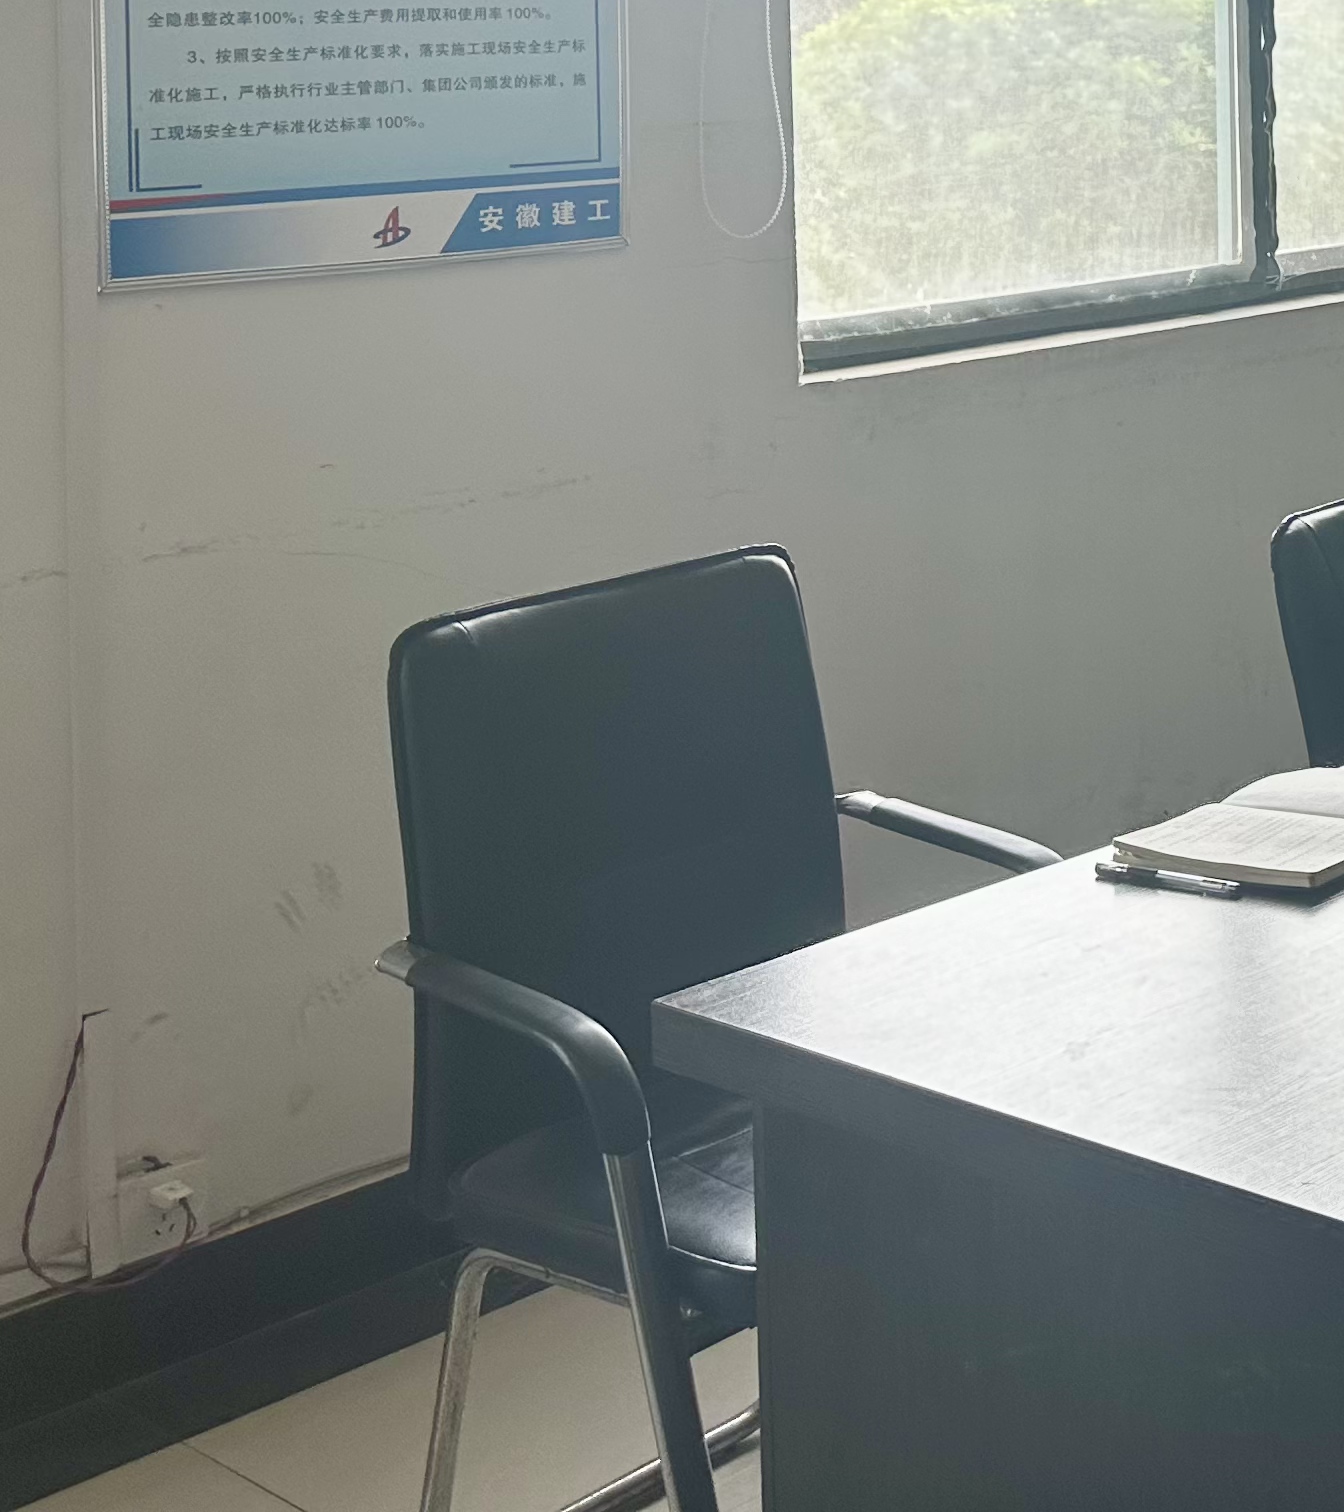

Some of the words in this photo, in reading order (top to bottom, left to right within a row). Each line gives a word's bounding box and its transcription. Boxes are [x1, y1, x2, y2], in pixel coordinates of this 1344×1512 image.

[186, 38, 587, 66] 3、按照安全生产标准化要求，落实施工现场安全生产标
[478, 199, 611, 233] 安徽建工
